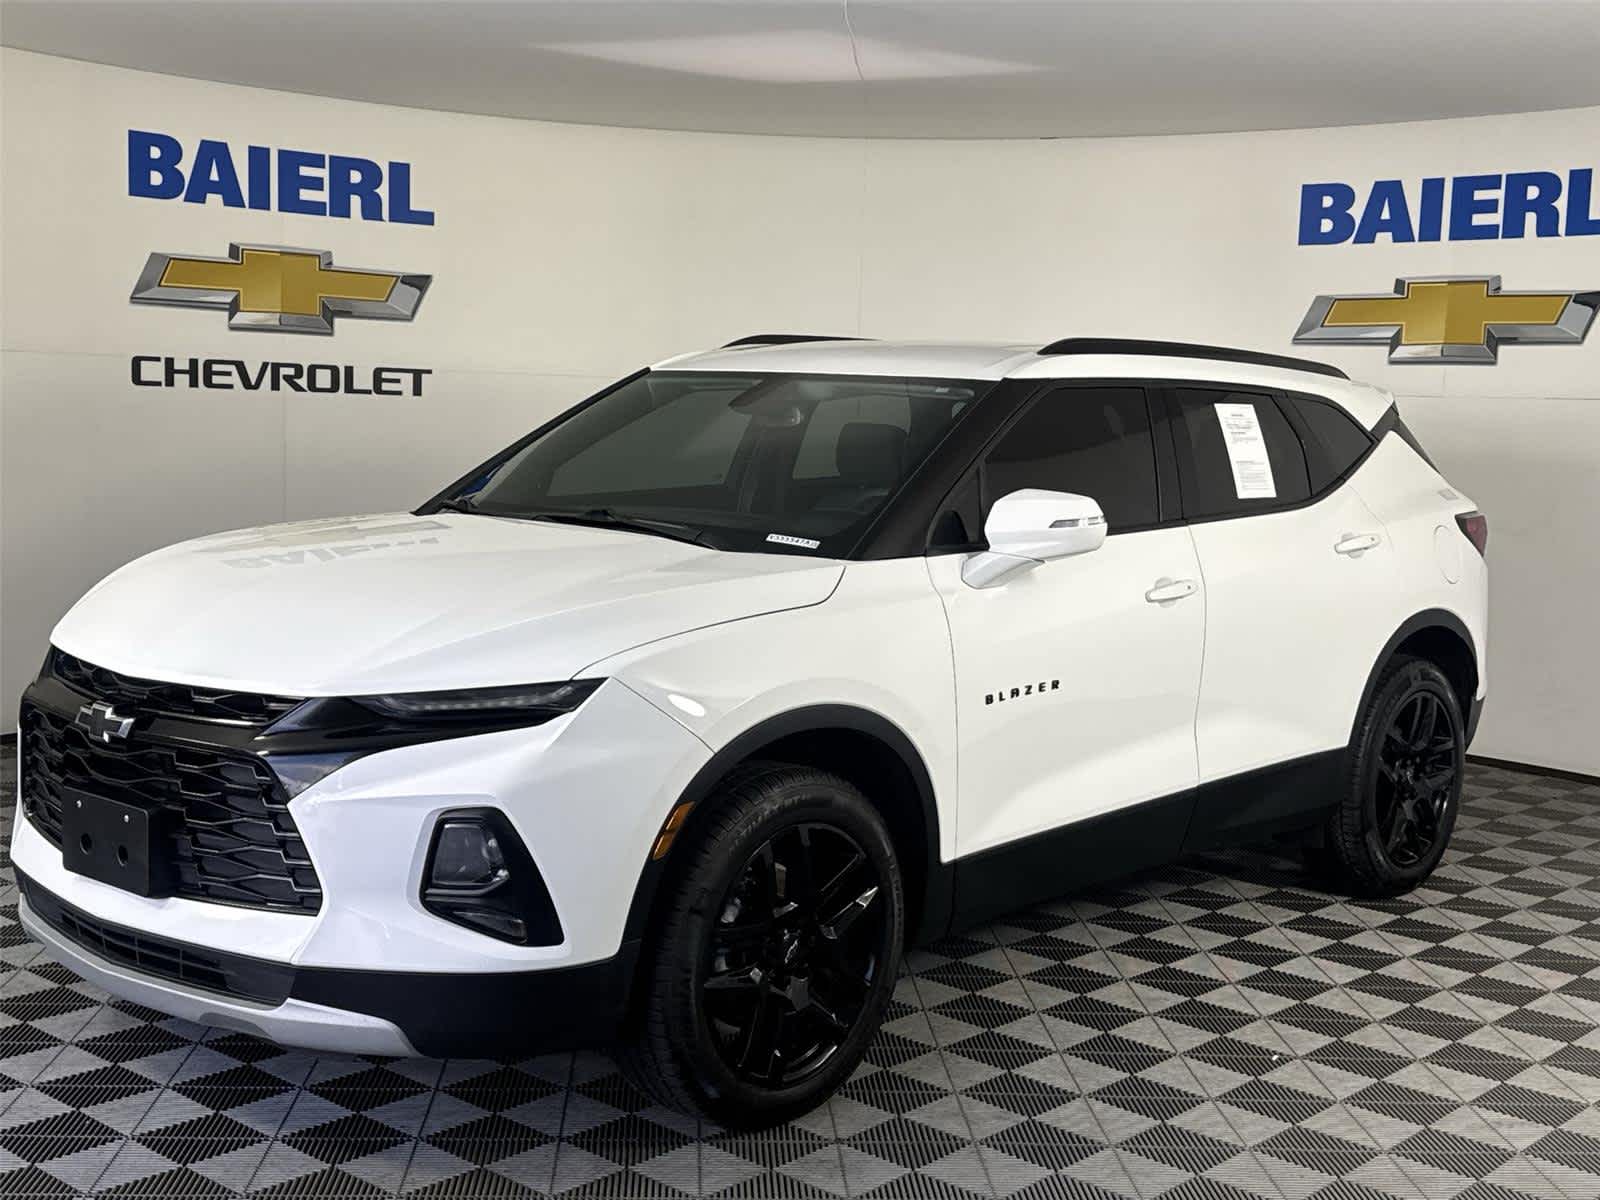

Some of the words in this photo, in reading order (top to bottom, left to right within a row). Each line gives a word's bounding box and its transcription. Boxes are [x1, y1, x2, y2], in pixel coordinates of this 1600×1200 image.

[128, 130, 434, 225] BAIERL
[1298, 168, 1600, 245] BAIERL
[131, 355, 433, 397] CHEVROLET
[984, 679, 1061, 706] BLAZER
